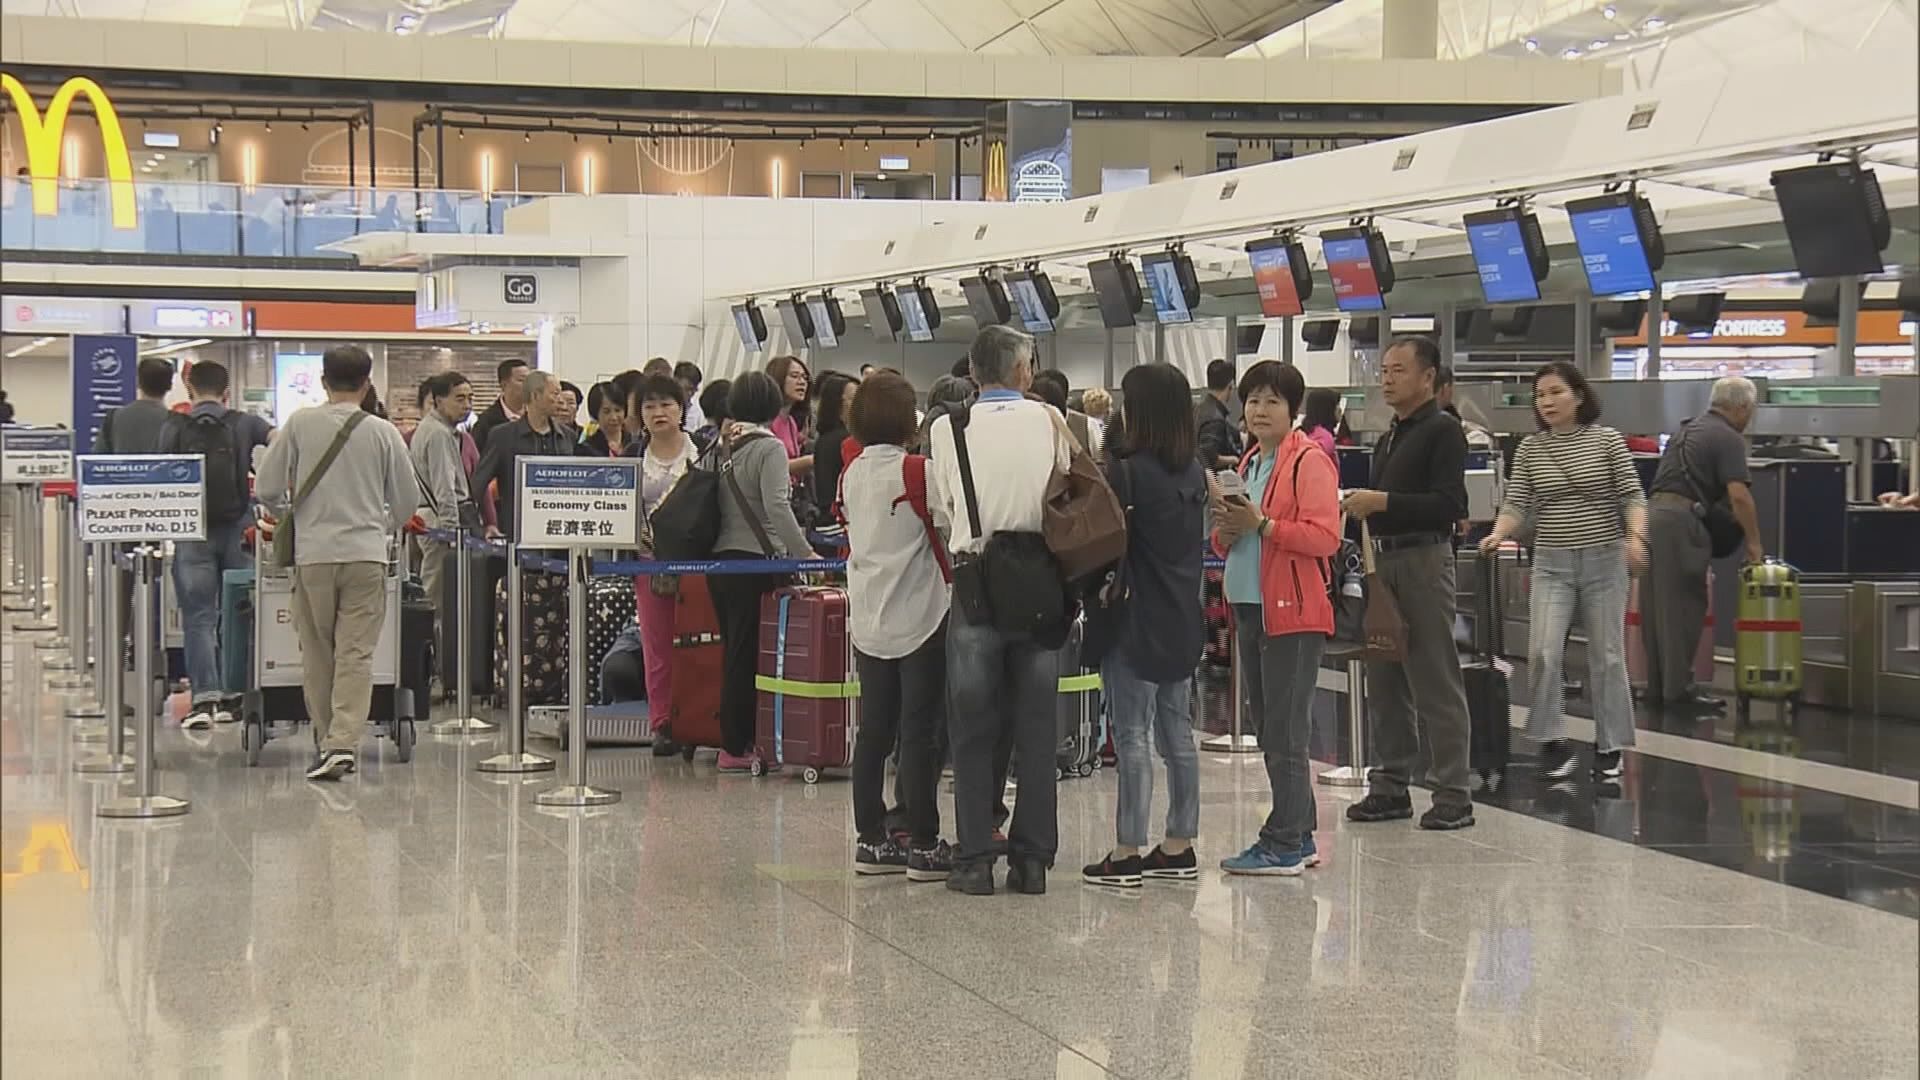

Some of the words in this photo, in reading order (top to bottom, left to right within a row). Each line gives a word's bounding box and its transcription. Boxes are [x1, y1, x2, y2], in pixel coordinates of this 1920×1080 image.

[507, 278, 533, 295] Go
[91, 464, 149, 473] AEROFLOT
[534, 469, 588, 478] AEROFLOT
[533, 499, 590, 512] Economy
[593, 500, 627, 511] Class
[86, 508, 126, 519] PLEASE
[129, 508, 181, 518] PROCEED
[88, 523, 143, 534] COUNTER
[170, 521, 197, 533] D15
[545, 519, 614, 536] 經濟客位
